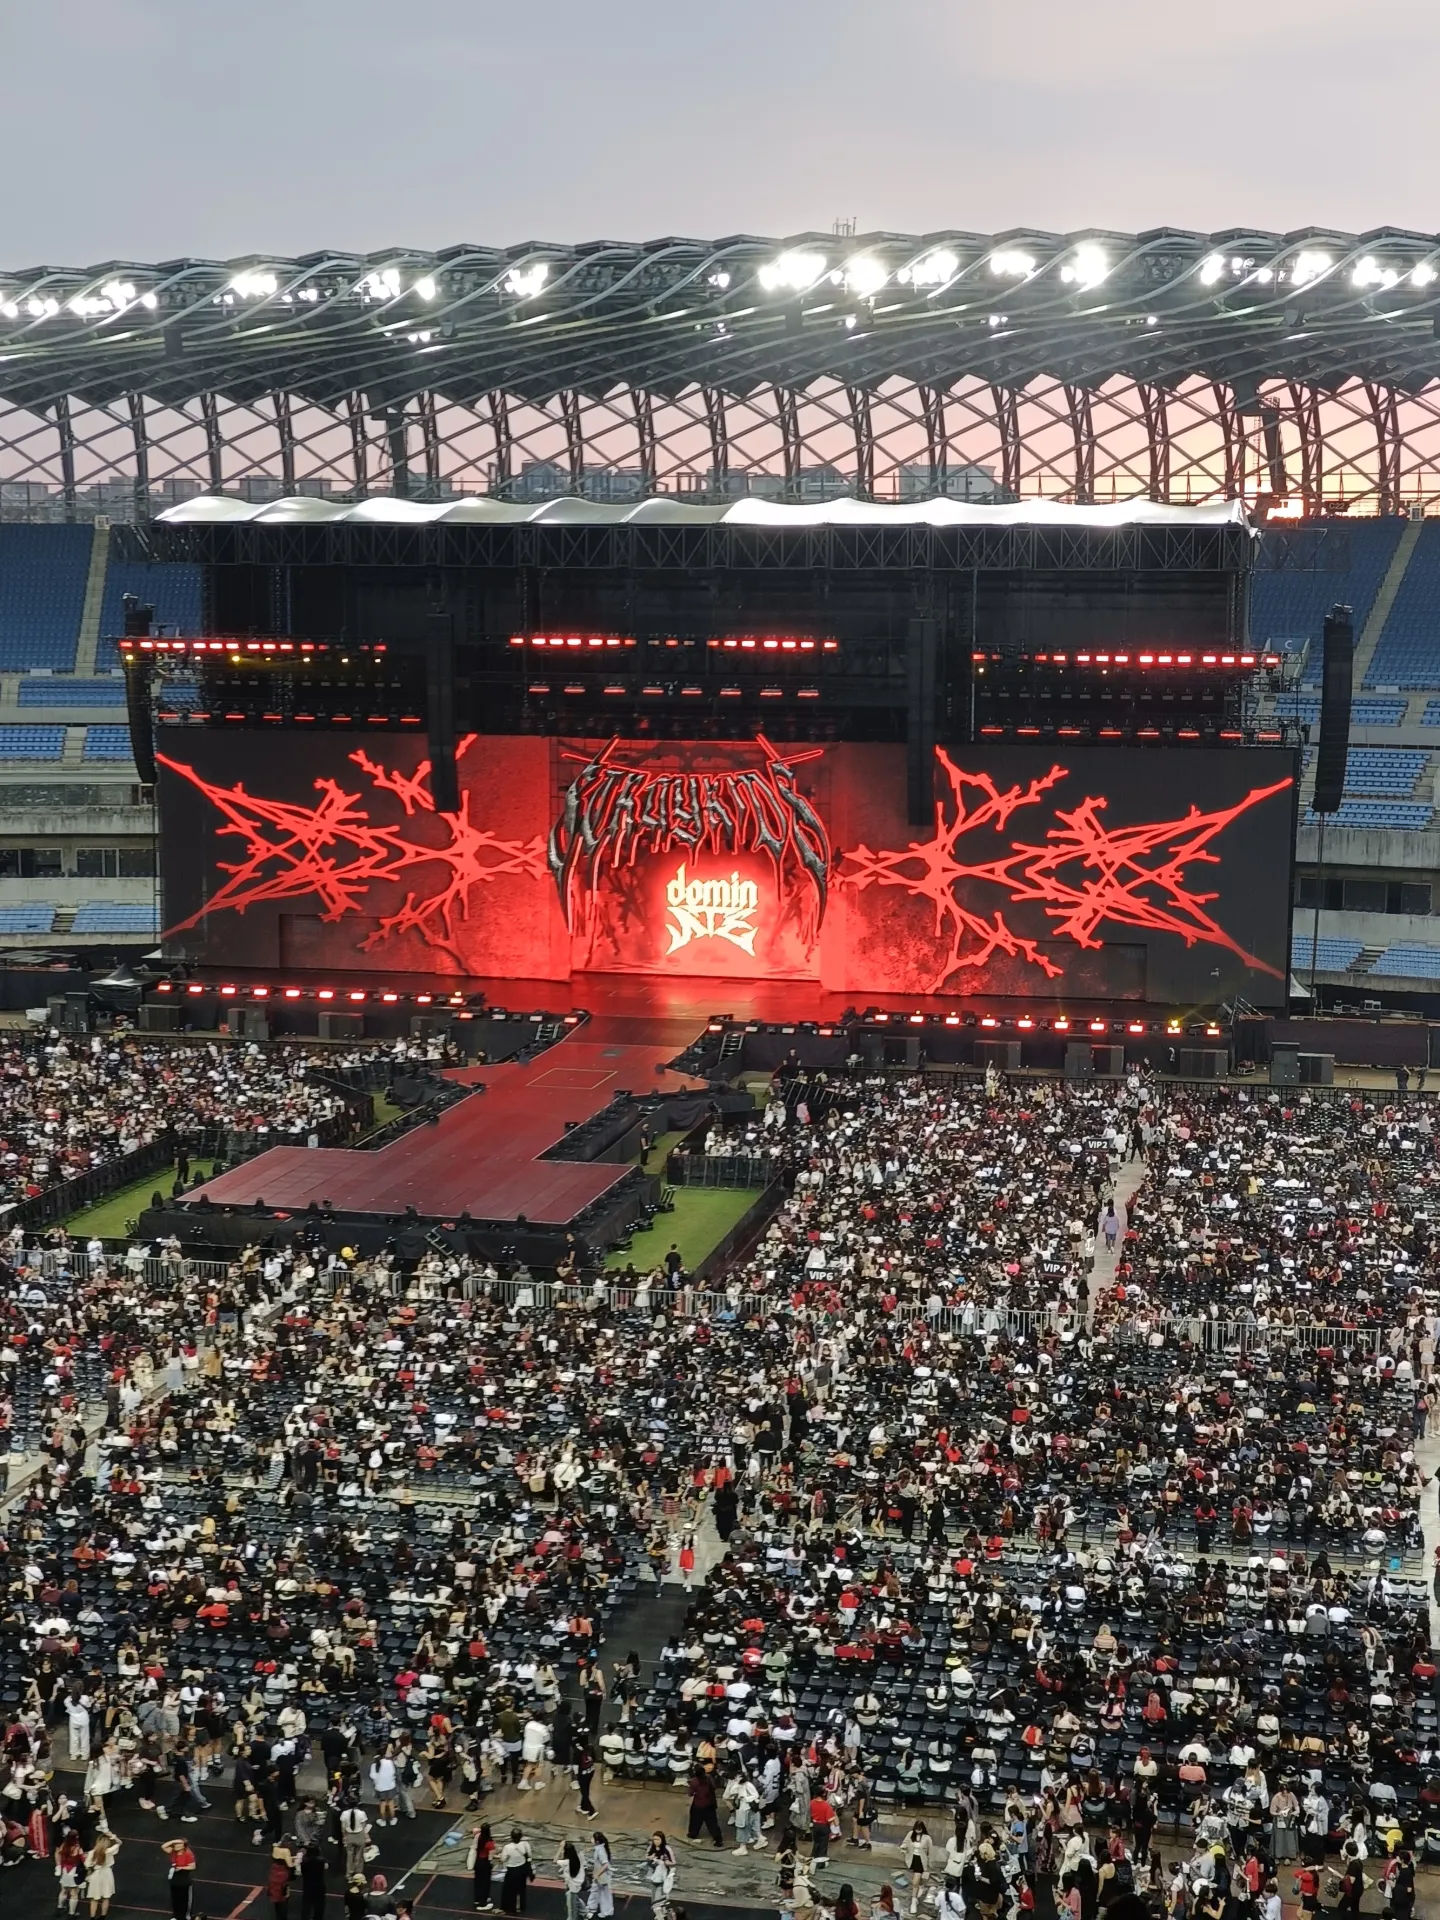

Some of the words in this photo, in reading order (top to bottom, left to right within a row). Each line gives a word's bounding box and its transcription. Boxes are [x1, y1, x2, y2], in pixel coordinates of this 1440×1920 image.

[1088, 1140, 1108, 1149] VIP2
[1043, 1263, 1067, 1274] VIP4
[809, 1270, 834, 1281] VIP6
